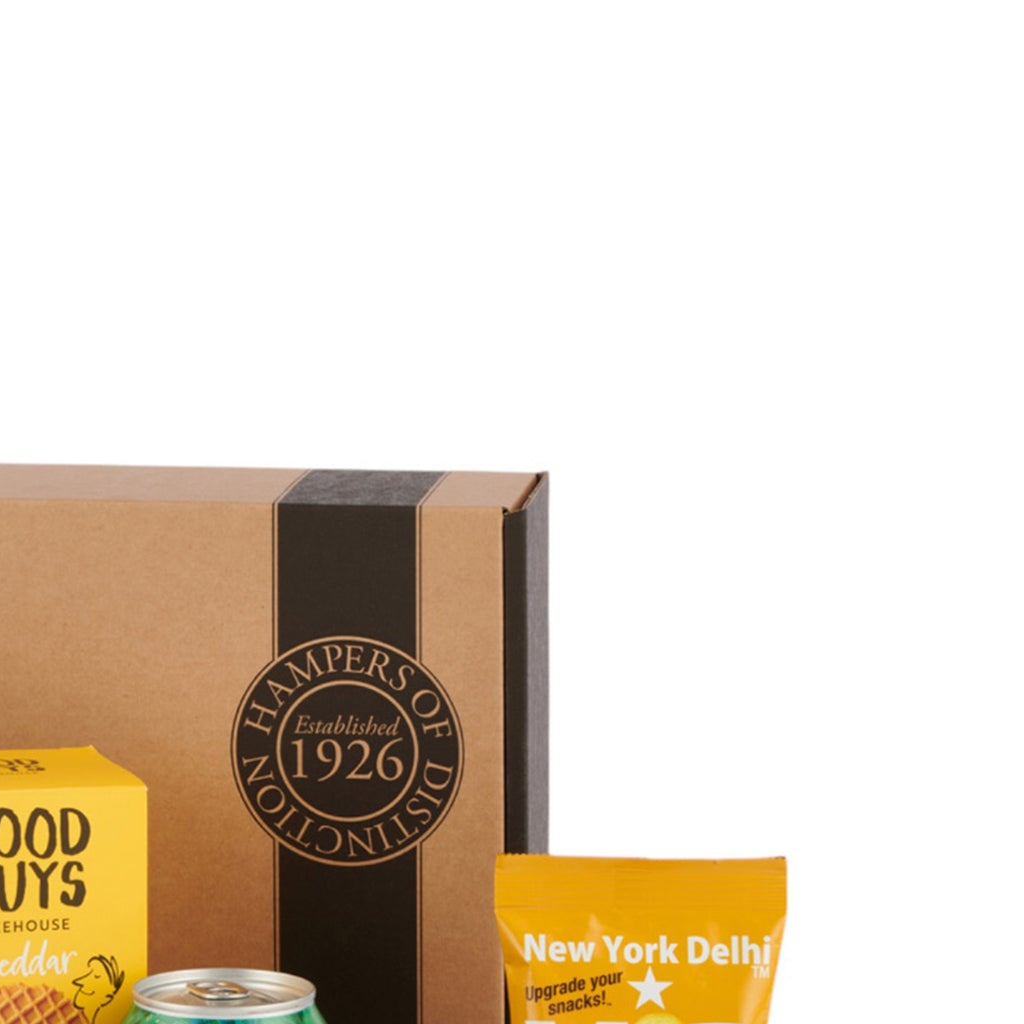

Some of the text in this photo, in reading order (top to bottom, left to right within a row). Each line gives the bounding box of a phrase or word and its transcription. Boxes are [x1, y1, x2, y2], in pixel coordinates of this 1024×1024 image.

[294, 715, 401, 736] Established
[242, 644, 454, 857] HAMPERS OF DISTINCTION
[290, 737, 404, 781] 1926
[523, 933, 771, 965] New York Delhi
[526, 971, 623, 1003] Upgrade your
[751, 965, 770, 978] TM
[548, 990, 607, 1016] snacks!
